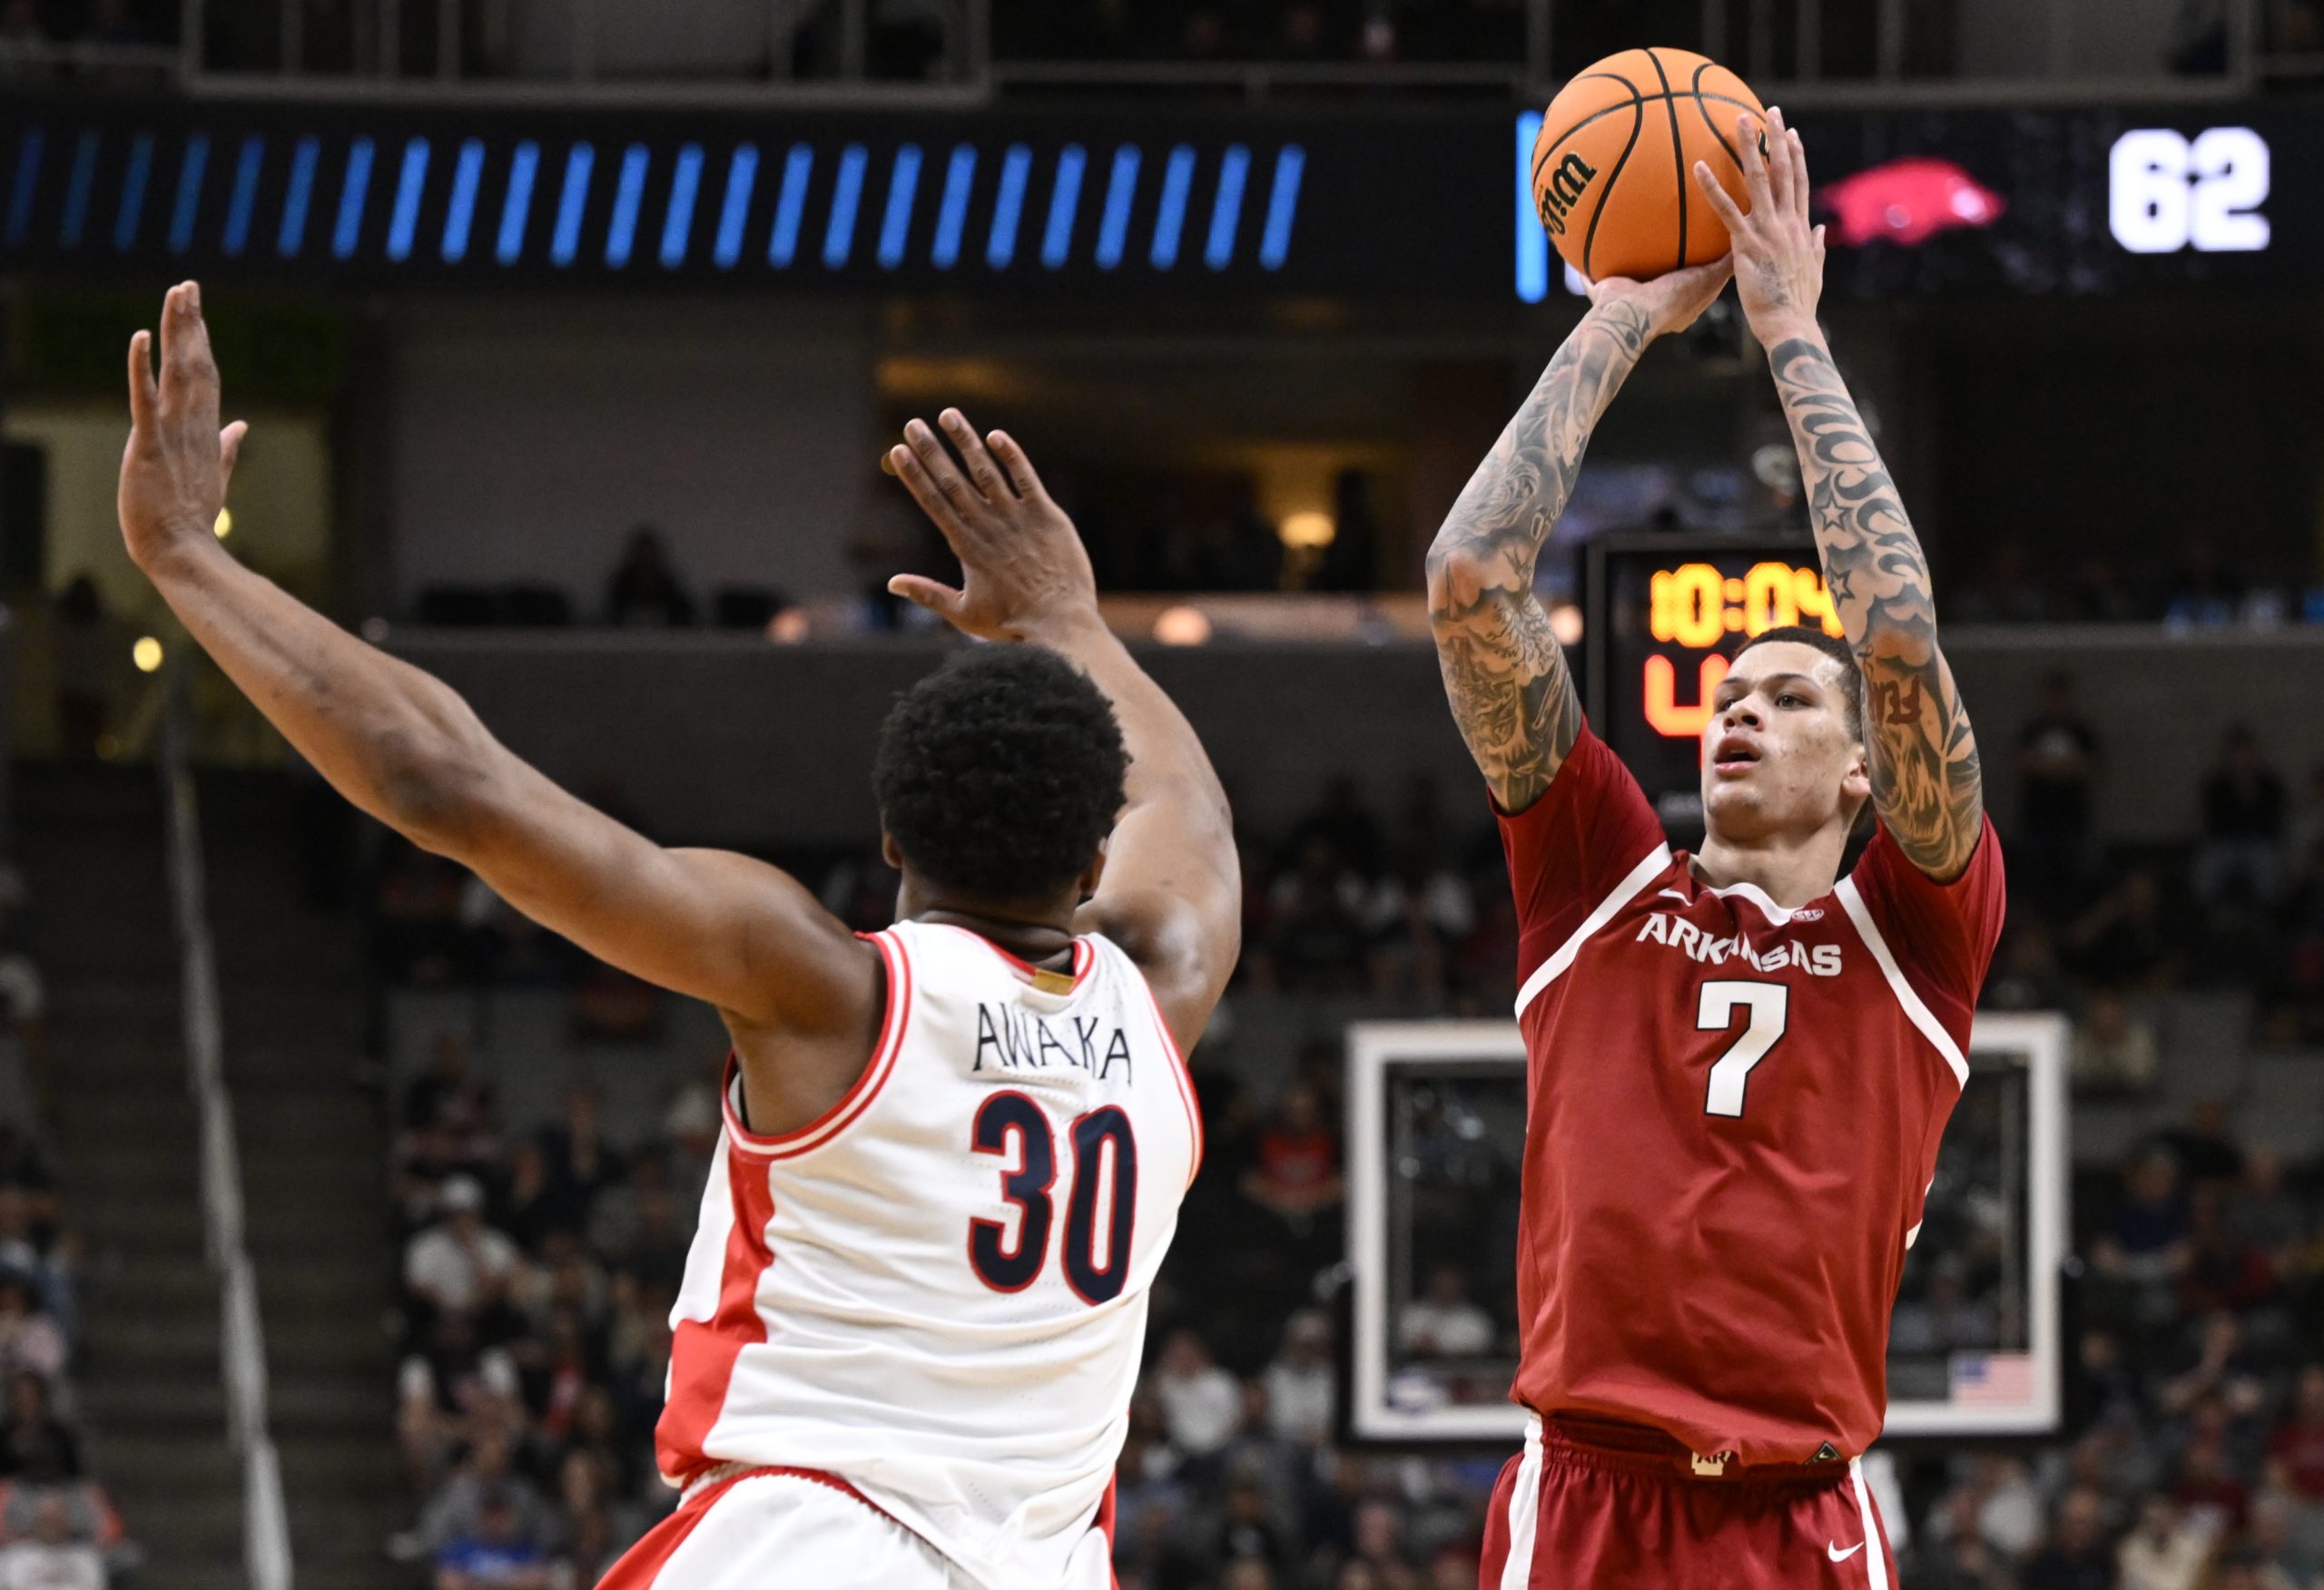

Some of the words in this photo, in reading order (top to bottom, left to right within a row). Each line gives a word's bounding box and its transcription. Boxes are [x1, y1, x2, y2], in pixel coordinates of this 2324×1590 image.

[2109, 126, 2270, 253] 62
[1650, 562, 1845, 648] 10:04
[1635, 912, 1842, 977] ARKANSAS
[973, 1002, 1132, 1089] AWAKA
[1695, 979, 1790, 1118] 7
[967, 1089, 1137, 1306] 30
